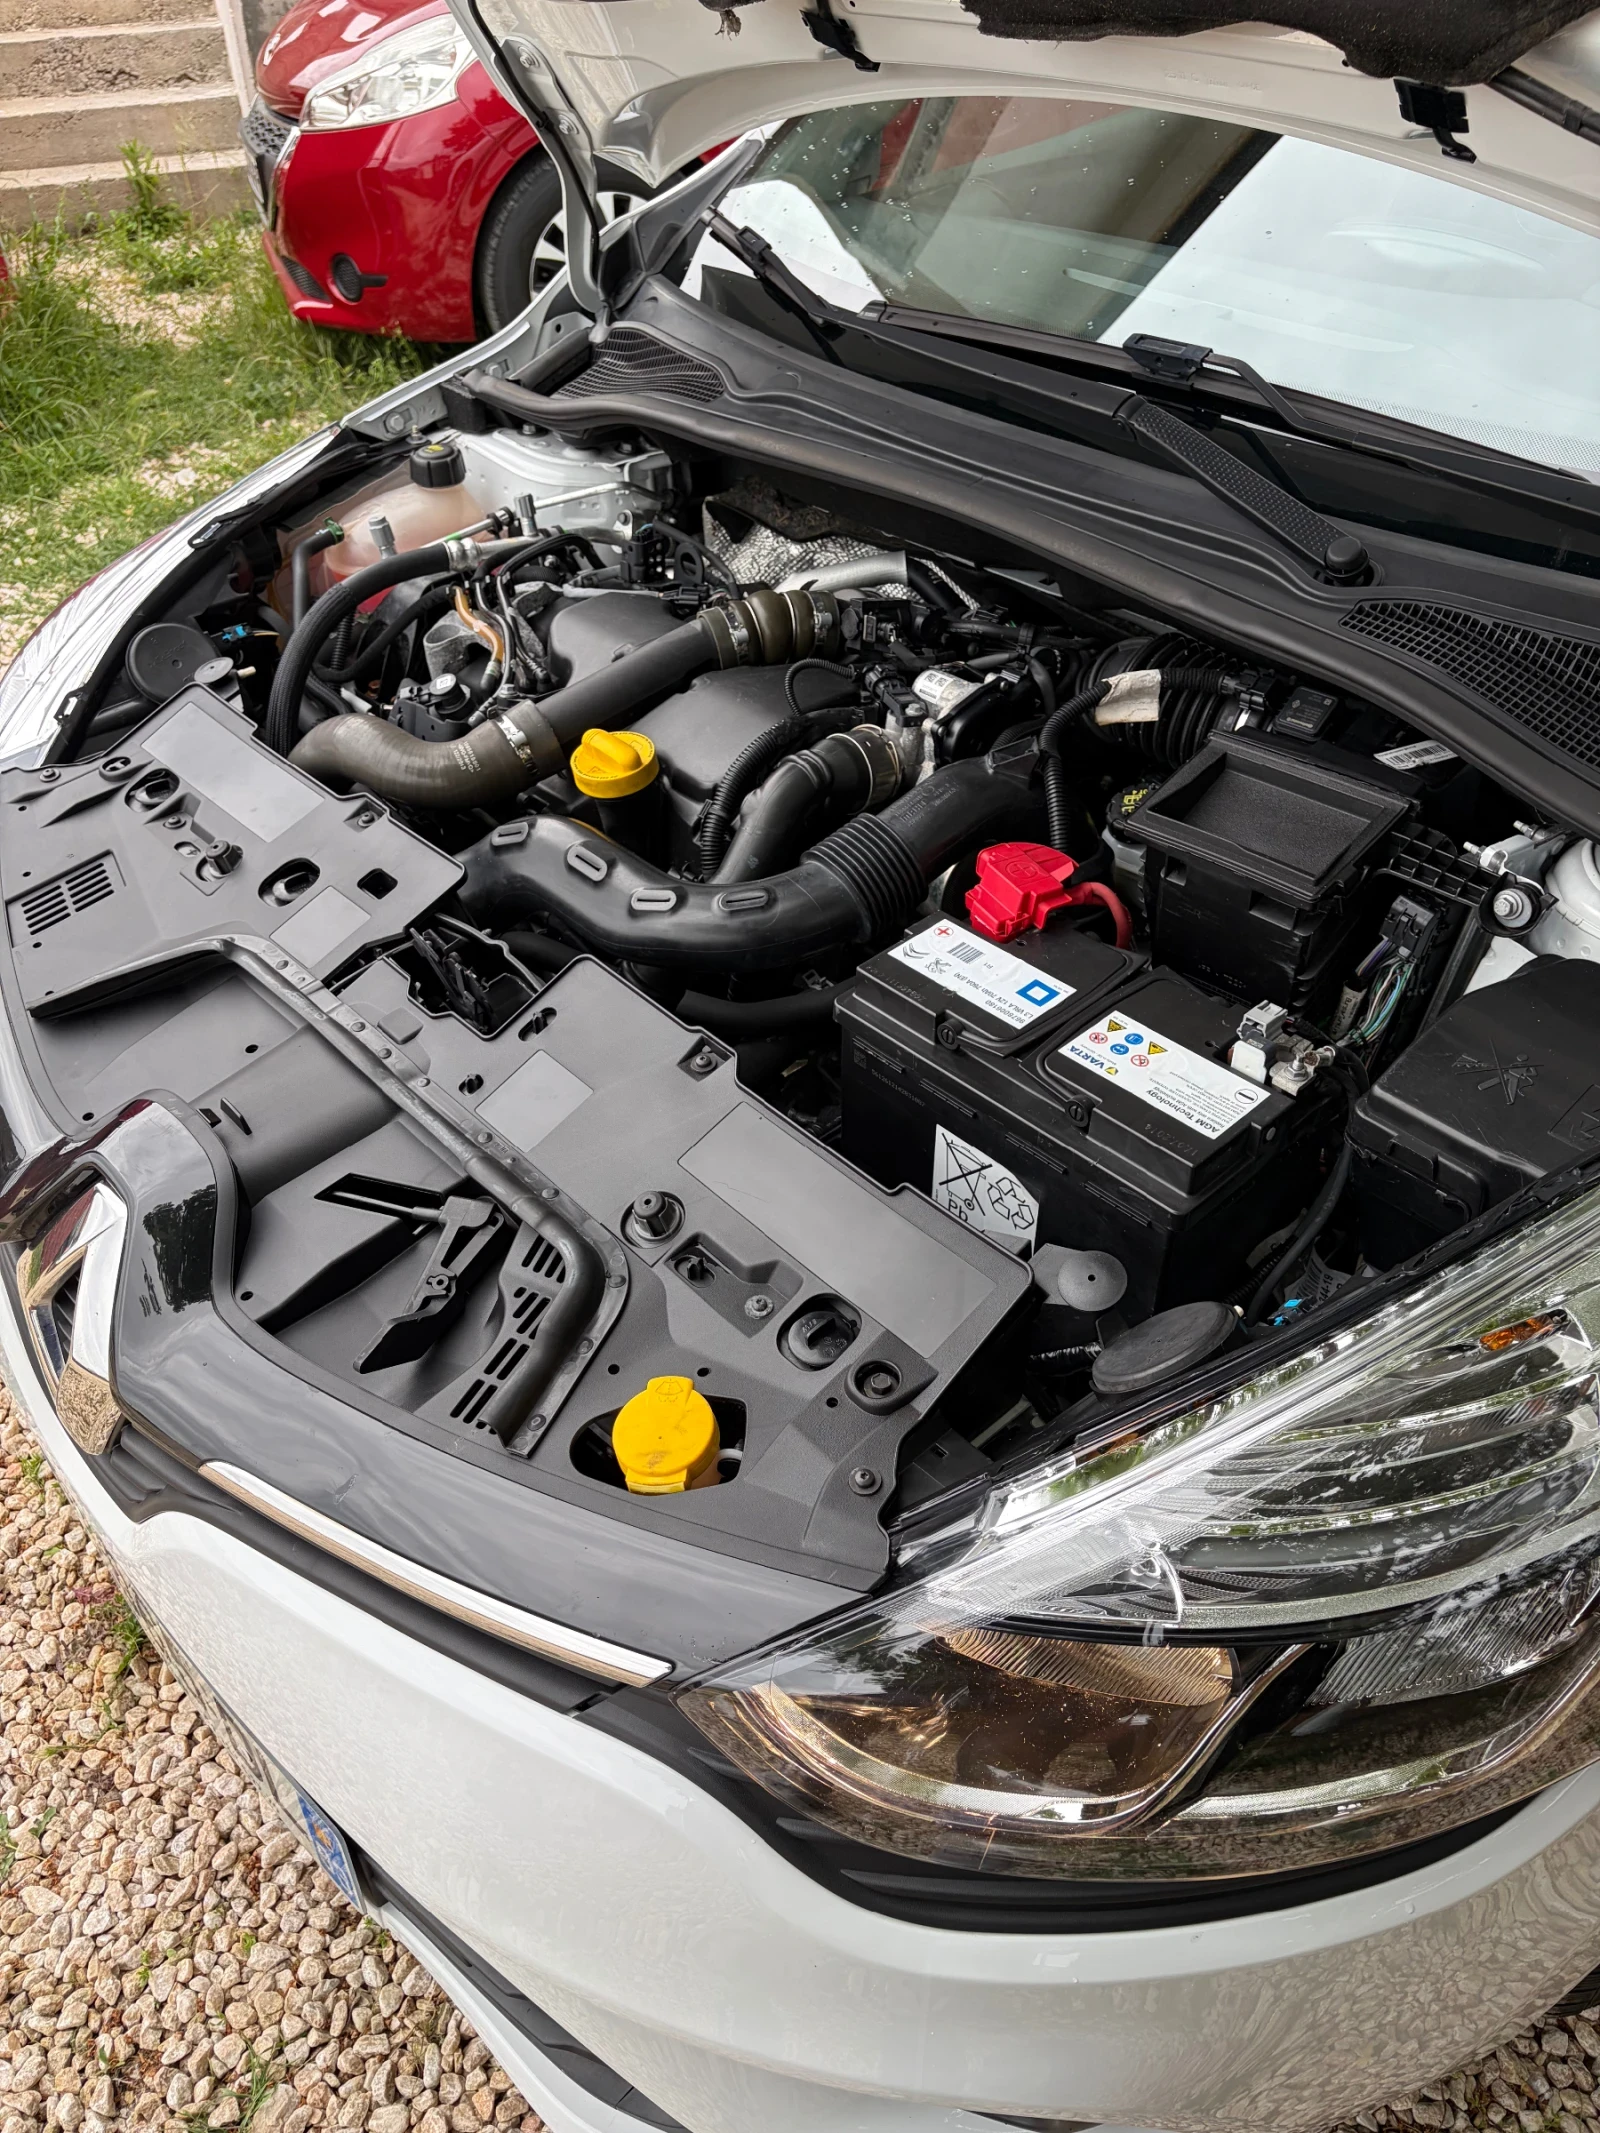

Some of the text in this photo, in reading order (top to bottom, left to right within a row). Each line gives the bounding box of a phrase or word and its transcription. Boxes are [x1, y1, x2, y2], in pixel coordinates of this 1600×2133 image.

[995, 996, 1008, 1005] 12V
[1008, 1003, 1024, 1014] VRLA
[1070, 1045, 1105, 1069] VARTA
[1146, 1090, 1194, 1121] Technology
[1195, 1118, 1220, 1133] AGM
[948, 1198, 969, 1222] Pb
